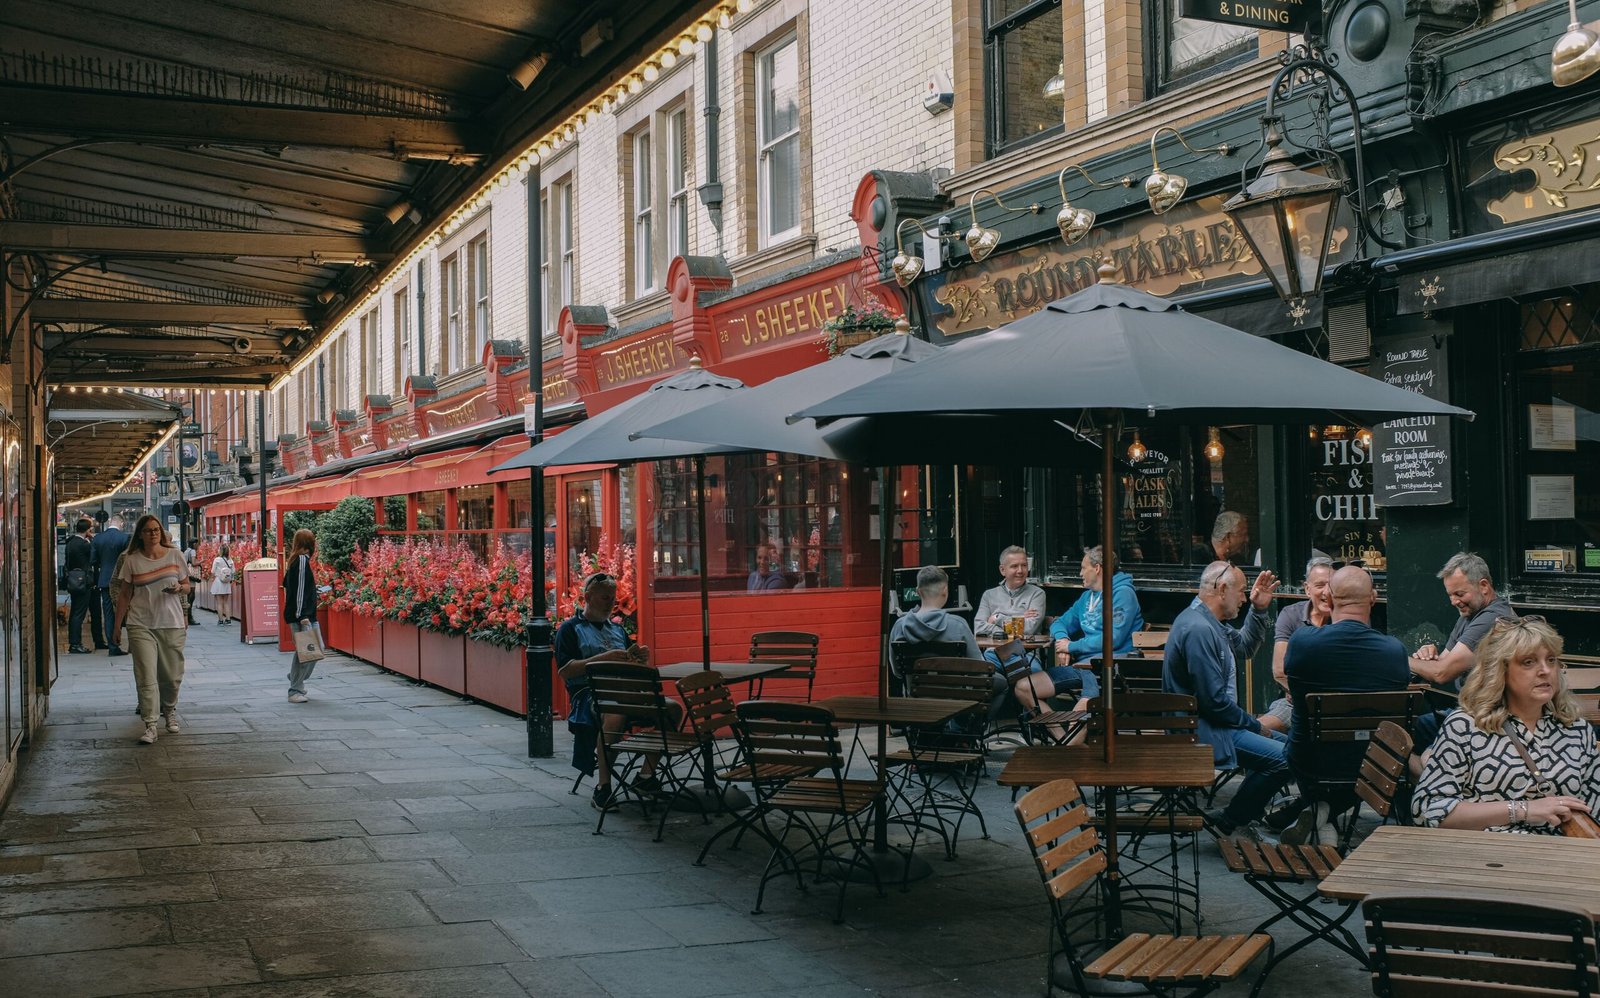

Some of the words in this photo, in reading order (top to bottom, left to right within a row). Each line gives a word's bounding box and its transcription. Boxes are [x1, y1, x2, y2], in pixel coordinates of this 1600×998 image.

[1220, 2, 1230, 16] &
[1235, 3, 1290, 24] DINING
[993, 255, 1101, 313] ROUND
[1111, 219, 1237, 285] TABLE
[742, 283, 847, 346] J.SHEEKEY
[607, 338, 676, 384] J.SHEEKEY
[1394, 430, 1428, 446] ROOM
[1135, 477, 1165, 491] CASK
[1348, 468, 1363, 489] &
[1136, 494, 1165, 508] ALES
[1344, 531, 1374, 543] SINE
[1340, 544, 1376, 559] 1860
